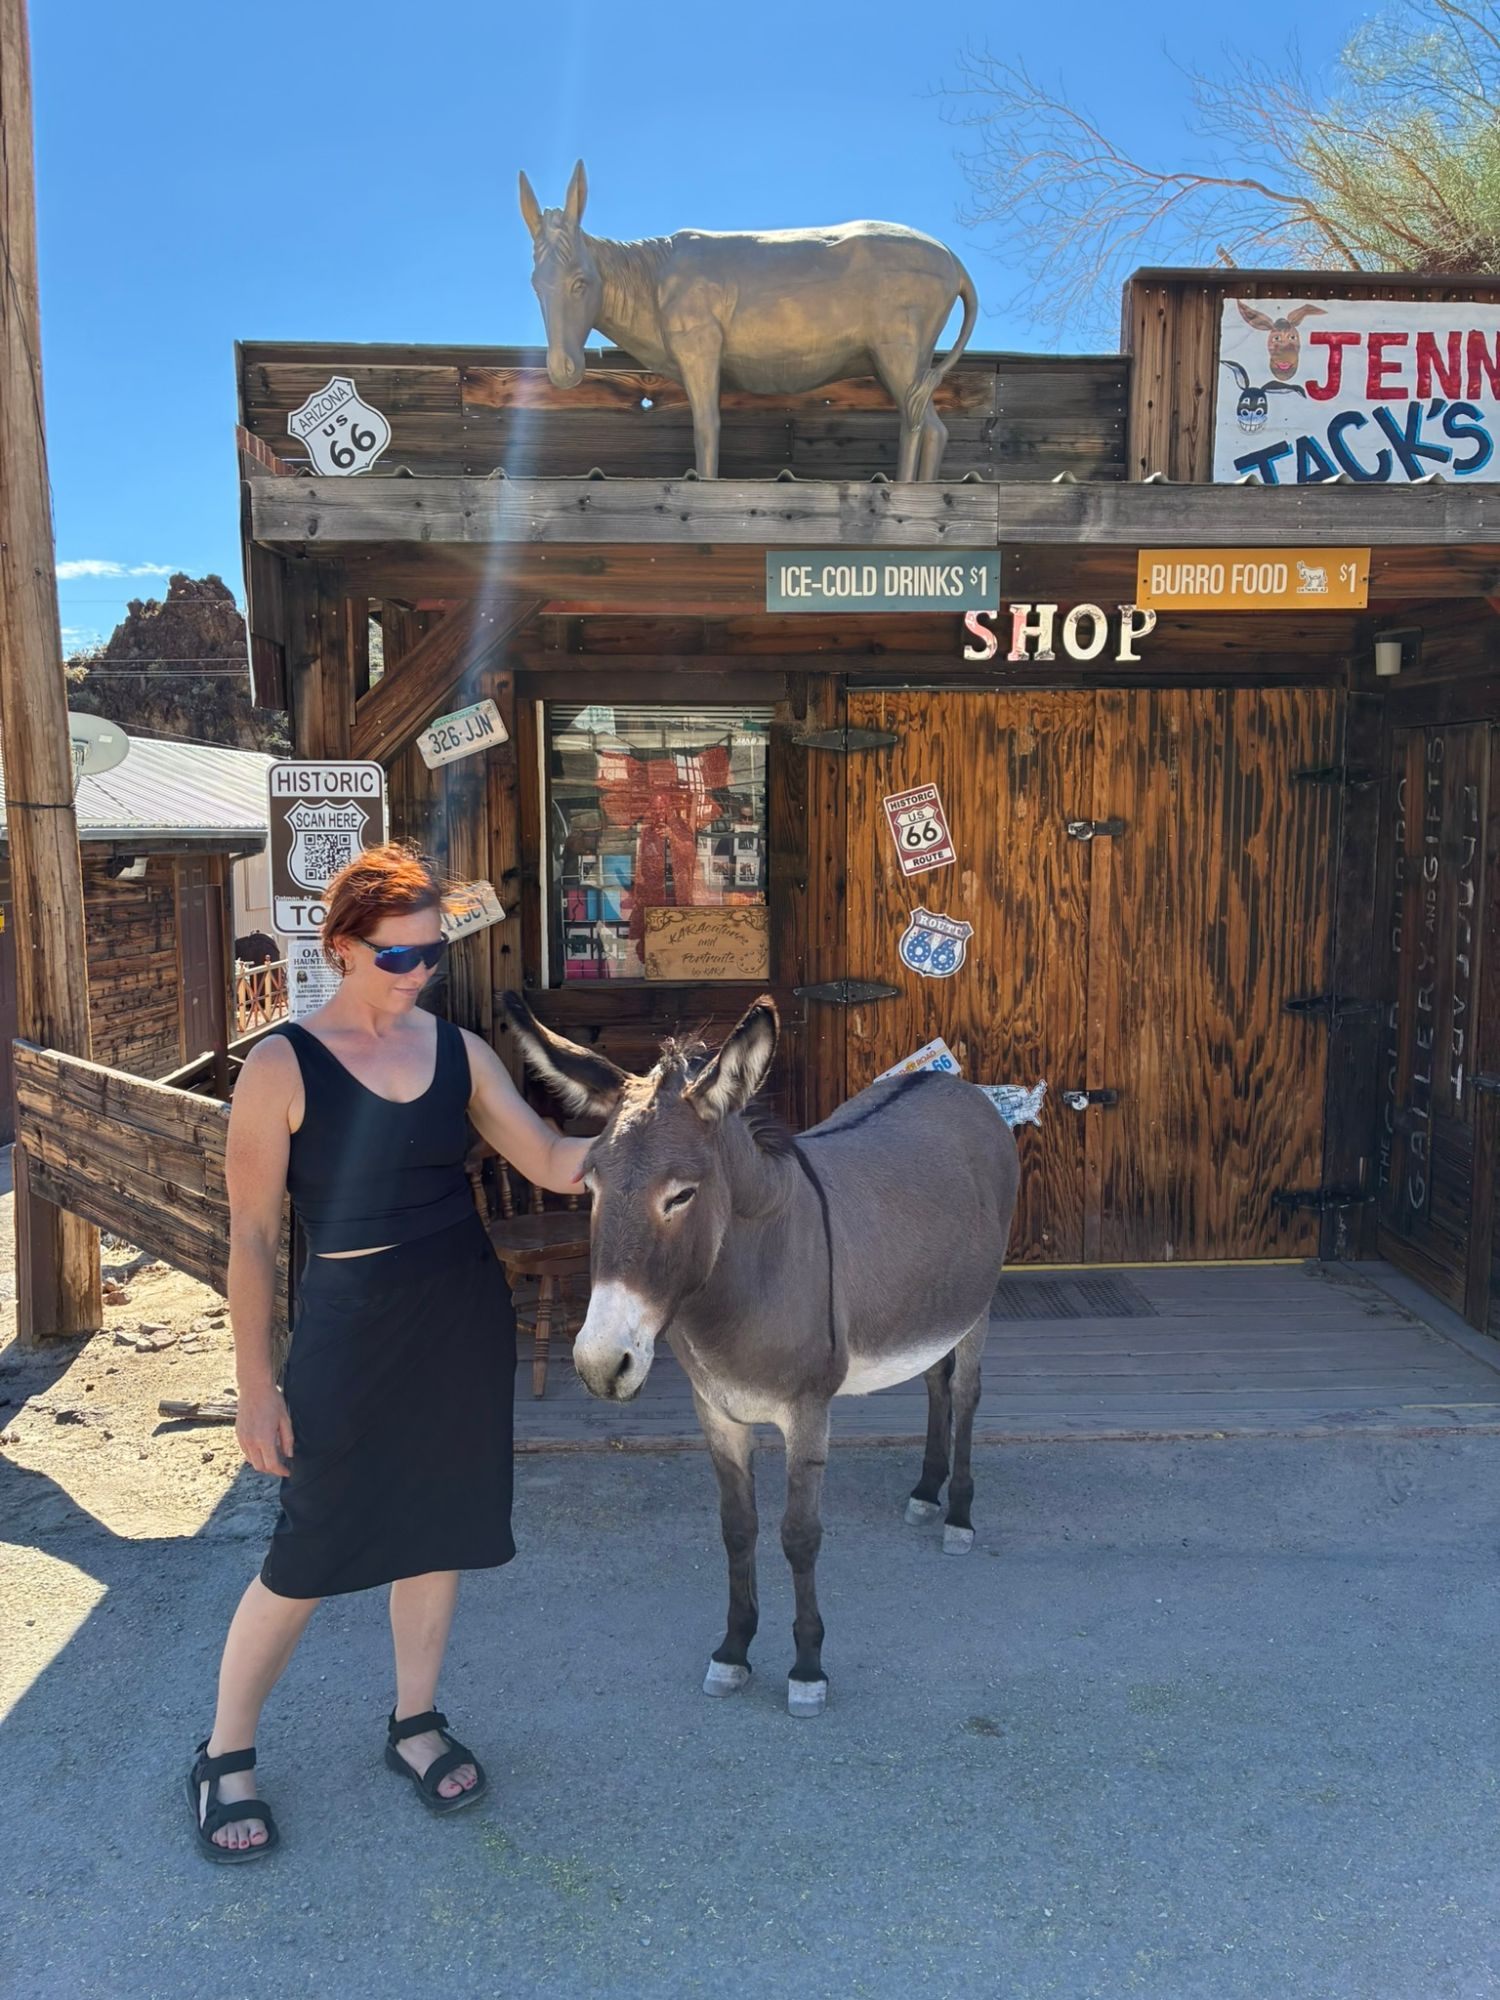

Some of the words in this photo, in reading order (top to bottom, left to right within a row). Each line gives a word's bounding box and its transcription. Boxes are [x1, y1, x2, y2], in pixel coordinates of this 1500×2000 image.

[298, 386, 348, 432] ARIZONA
[322, 414, 348, 437] US
[330, 423, 376, 469] 66
[780, 566, 877, 597] ICE-COLD
[884, 566, 964, 597] DRINKS
[970, 566, 987, 596] $1
[1151, 564, 1225, 594] BURRO
[1231, 563, 1288, 593] FOOD
[1339, 563, 1357, 593] $1
[963, 603, 1157, 661] SHOP
[277, 772, 374, 793] HISTORIC
[890, 791, 934, 811] HISTORIC
[1424, 737, 1444, 882] GIFTS
[296, 812, 326, 828] SCAN
[328, 812, 358, 828] HERE
[906, 821, 938, 847] 66
[912, 851, 944, 867] ROUTE
[918, 914, 964, 937] ROUTE
[1425, 889, 1436, 933] AND
[907, 930, 957, 971] 66
[932, 1054, 953, 1071] 66
[1409, 941, 1435, 1209] GALLERY
